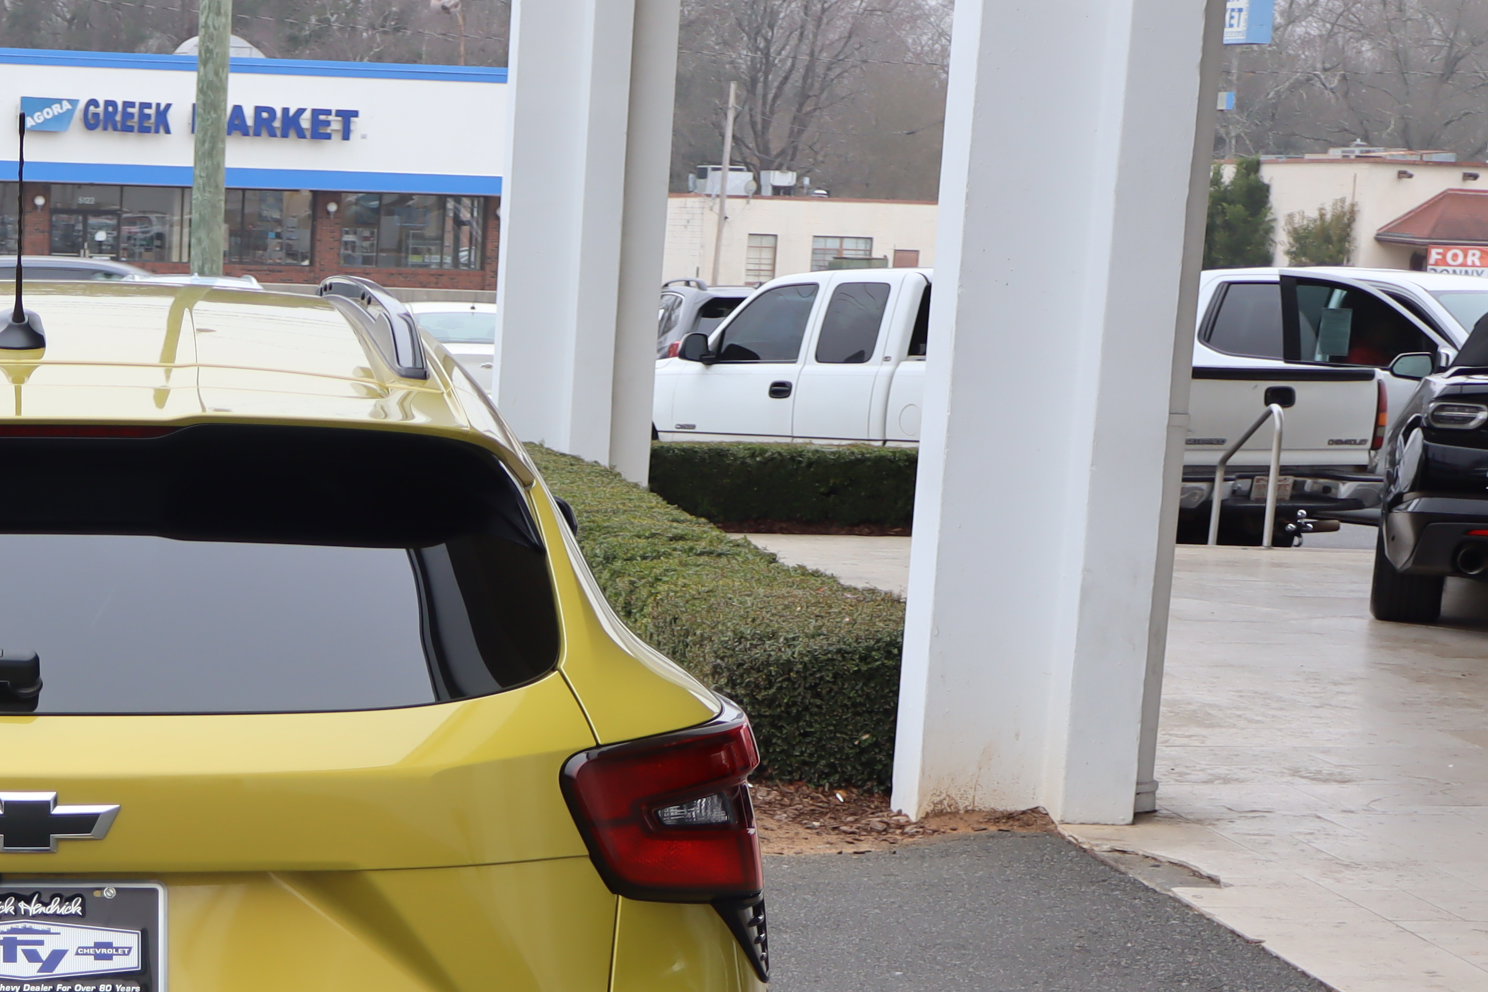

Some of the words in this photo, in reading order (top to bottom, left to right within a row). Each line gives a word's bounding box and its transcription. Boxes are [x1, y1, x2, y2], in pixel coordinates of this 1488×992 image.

[25, 100, 72, 129] AGORA
[83, 98, 173, 134] GREEK
[192, 103, 359, 140] ARKET
[1429, 248, 1481, 266] FOR
[18, 894, 82, 917] Hendrick
[77, 947, 130, 955] CHEVROLET
[23, 984, 53, 992] Dealer
[56, 984, 72, 992] For
[74, 984, 96, 992] Over
[99, 984, 112, 992] 80
[115, 984, 141, 992] Years
